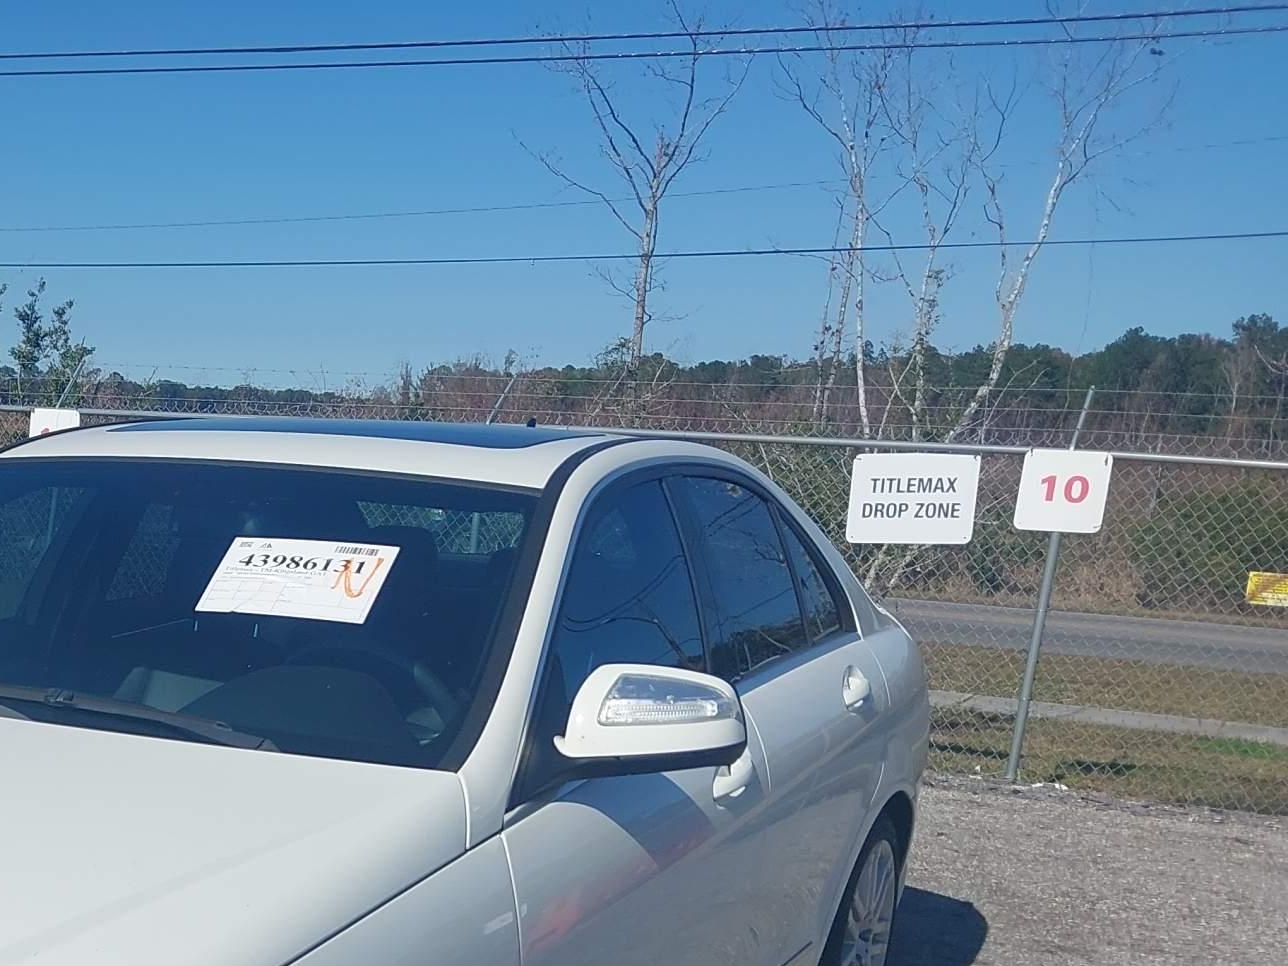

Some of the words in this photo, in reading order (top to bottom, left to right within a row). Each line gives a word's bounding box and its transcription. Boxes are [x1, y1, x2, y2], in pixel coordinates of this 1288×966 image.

[870, 477, 958, 494] TITLEMAX
[1041, 475, 1090, 504] 10
[861, 502, 909, 519] DROP
[913, 502, 961, 519] ZONE
[238, 552, 366, 574] 43986131
